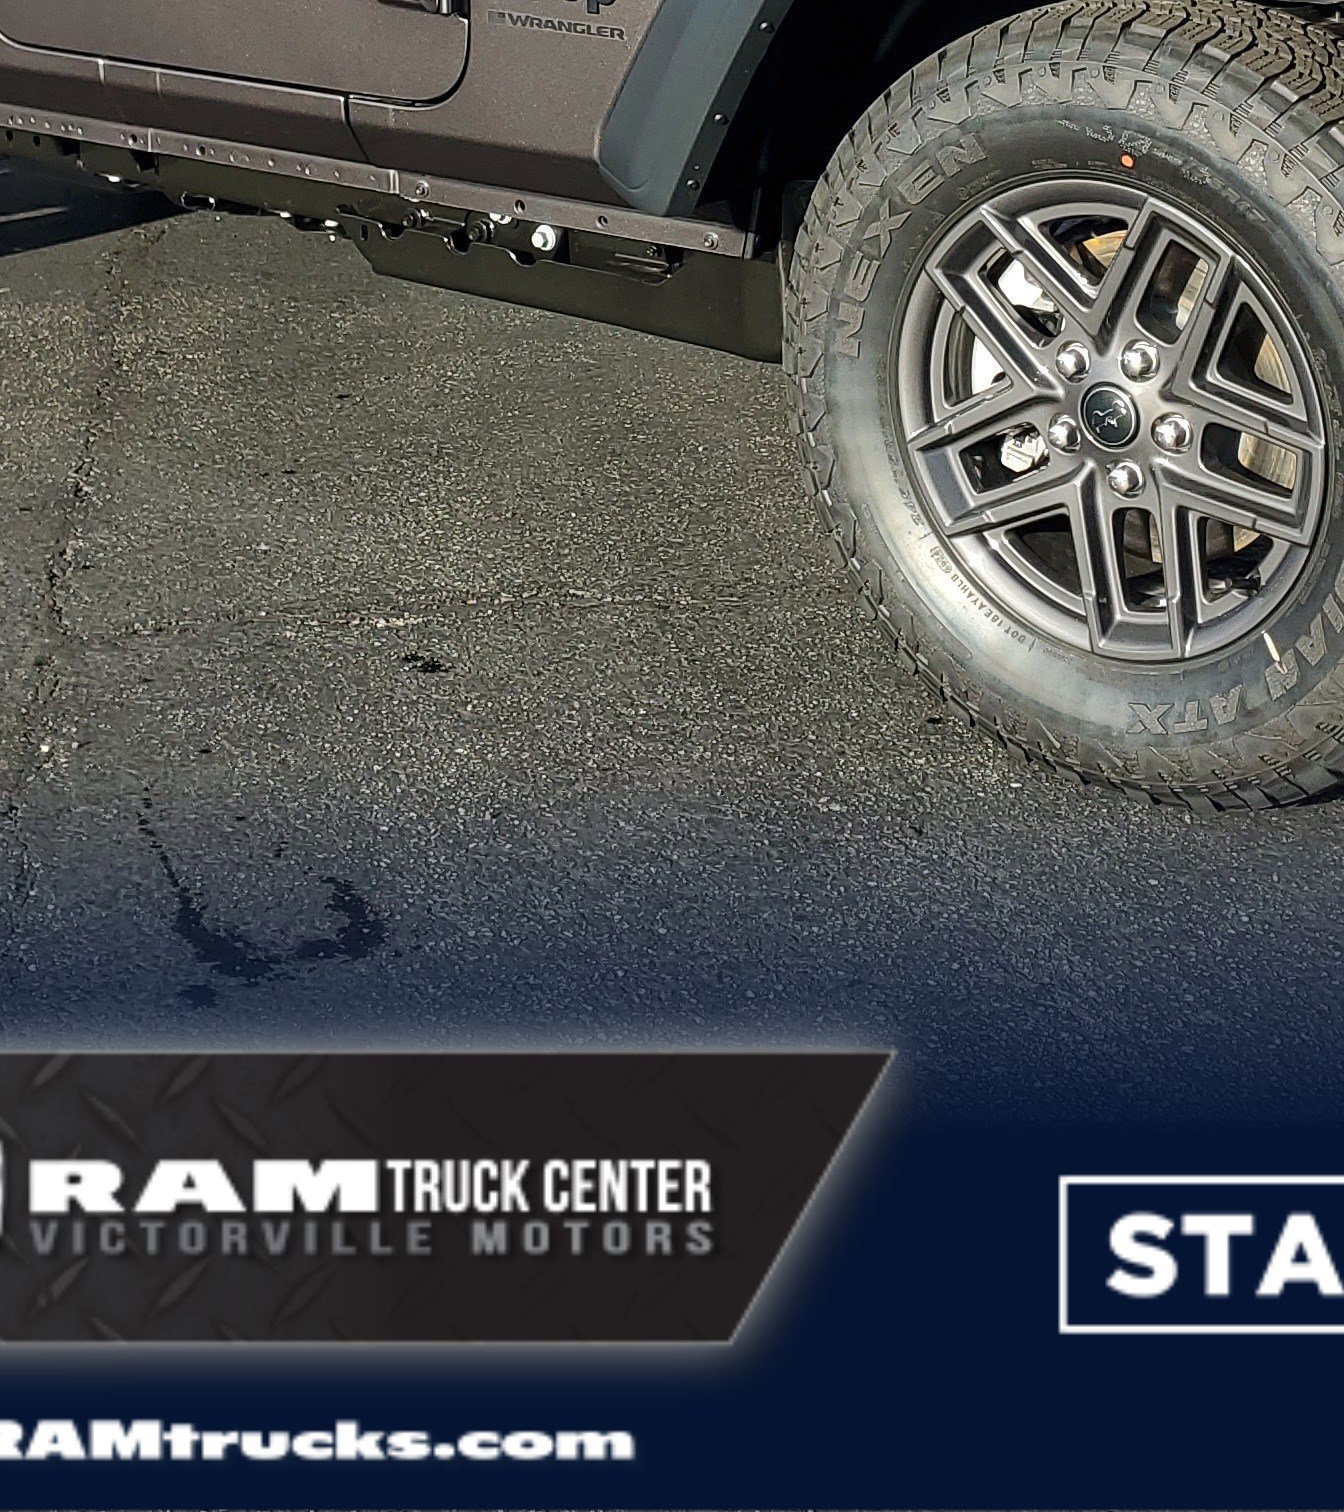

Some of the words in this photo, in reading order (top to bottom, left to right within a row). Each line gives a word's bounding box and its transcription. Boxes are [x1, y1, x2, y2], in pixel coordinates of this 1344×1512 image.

[507, 12, 626, 41] WRANGLER
[831, 132, 989, 359] NEXEN
[1125, 684, 1244, 736] ATX
